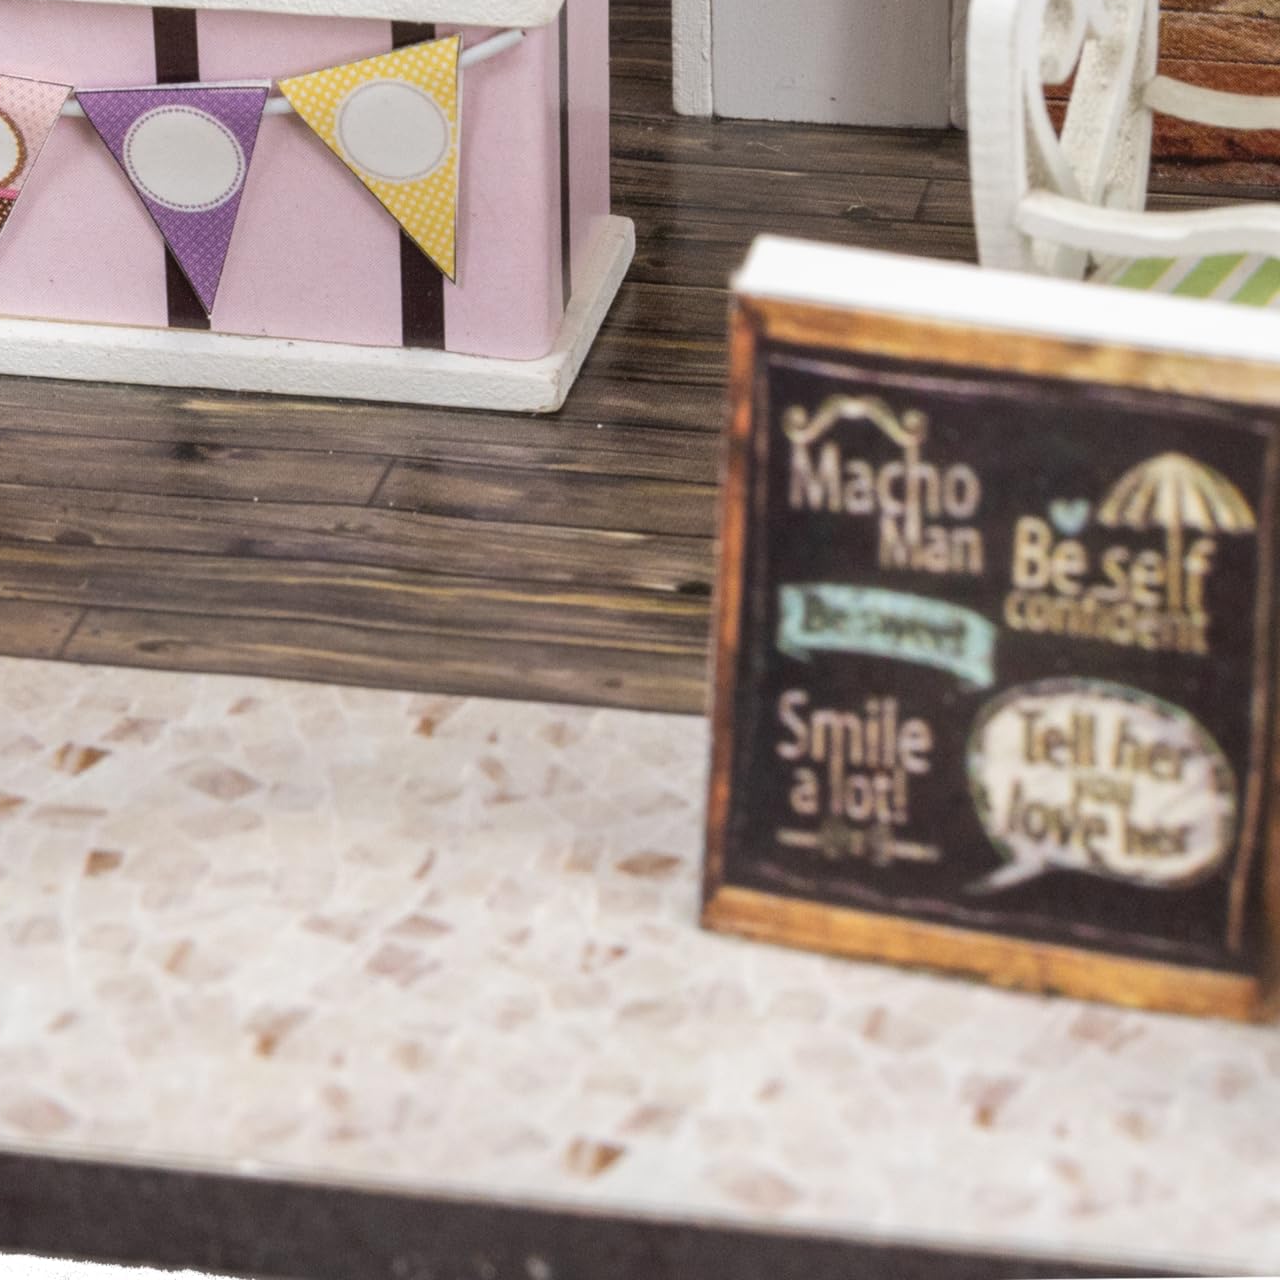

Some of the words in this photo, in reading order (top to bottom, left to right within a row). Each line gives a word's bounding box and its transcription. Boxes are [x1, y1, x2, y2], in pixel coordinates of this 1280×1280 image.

[786, 435, 983, 520] Macho
[880, 515, 984, 576] Man
[1012, 515, 1089, 597] Be
[1090, 535, 1219, 622] self
[775, 687, 934, 775] Smile
[1021, 707, 1097, 768] Tell
[789, 767, 819, 815] a
